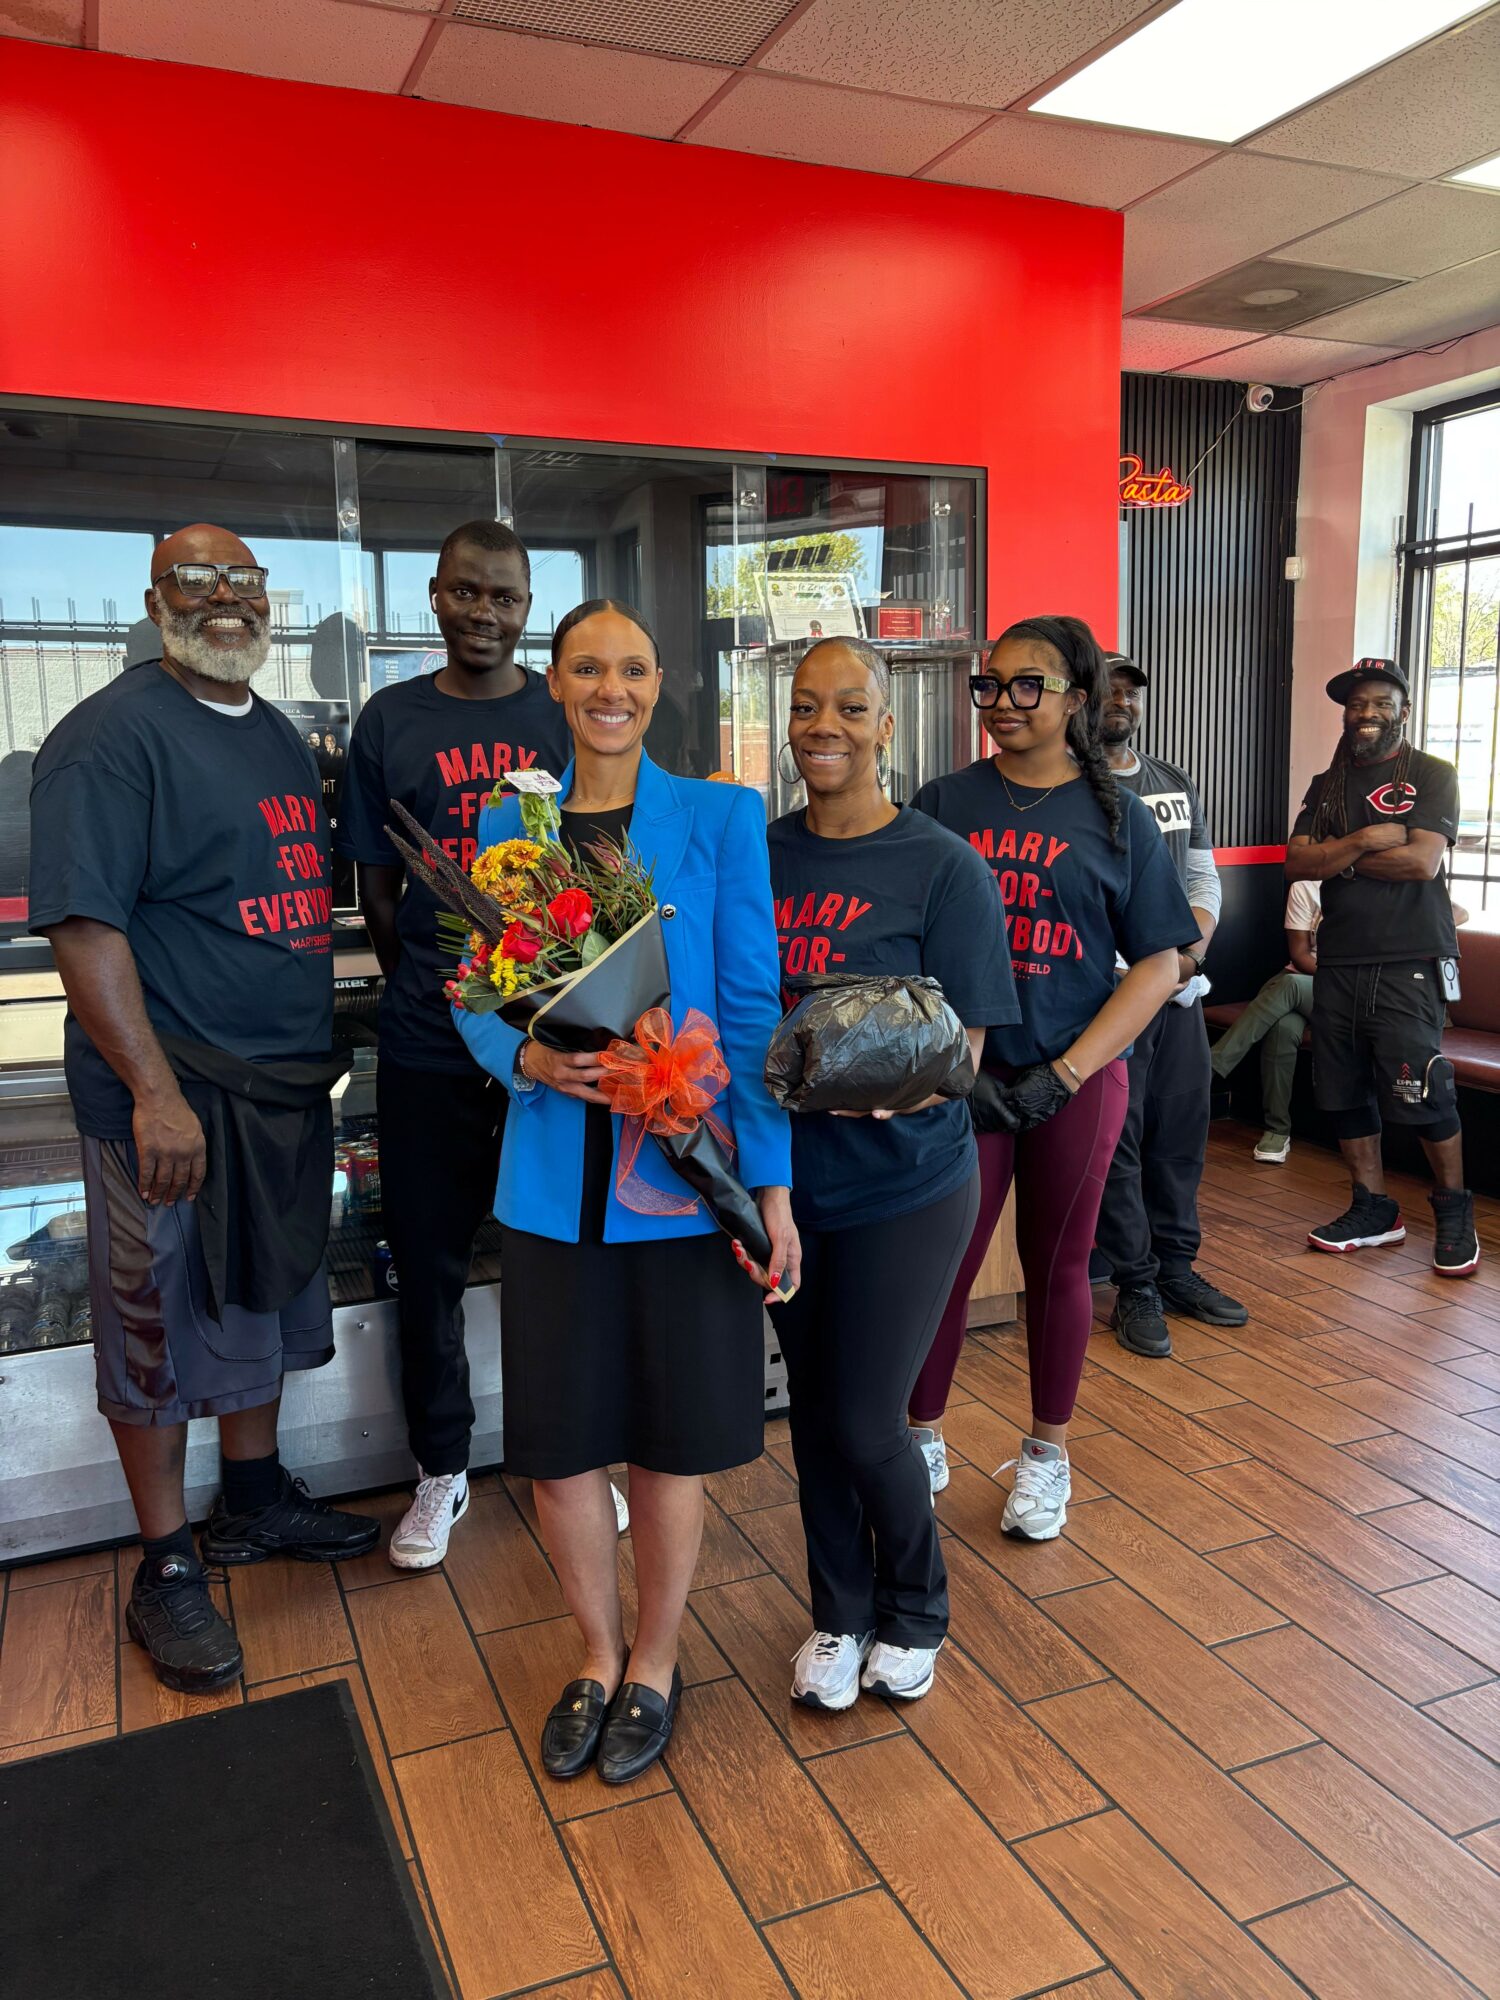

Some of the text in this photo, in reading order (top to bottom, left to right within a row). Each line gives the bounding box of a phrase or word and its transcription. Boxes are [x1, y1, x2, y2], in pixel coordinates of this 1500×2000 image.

[435, 742, 538, 788] MARY
[1170, 799, 1190, 821] IT.
[276, 842, 325, 882] -FOR-
[969, 828, 1070, 868] MARY
[773, 892, 873, 931] MARY
